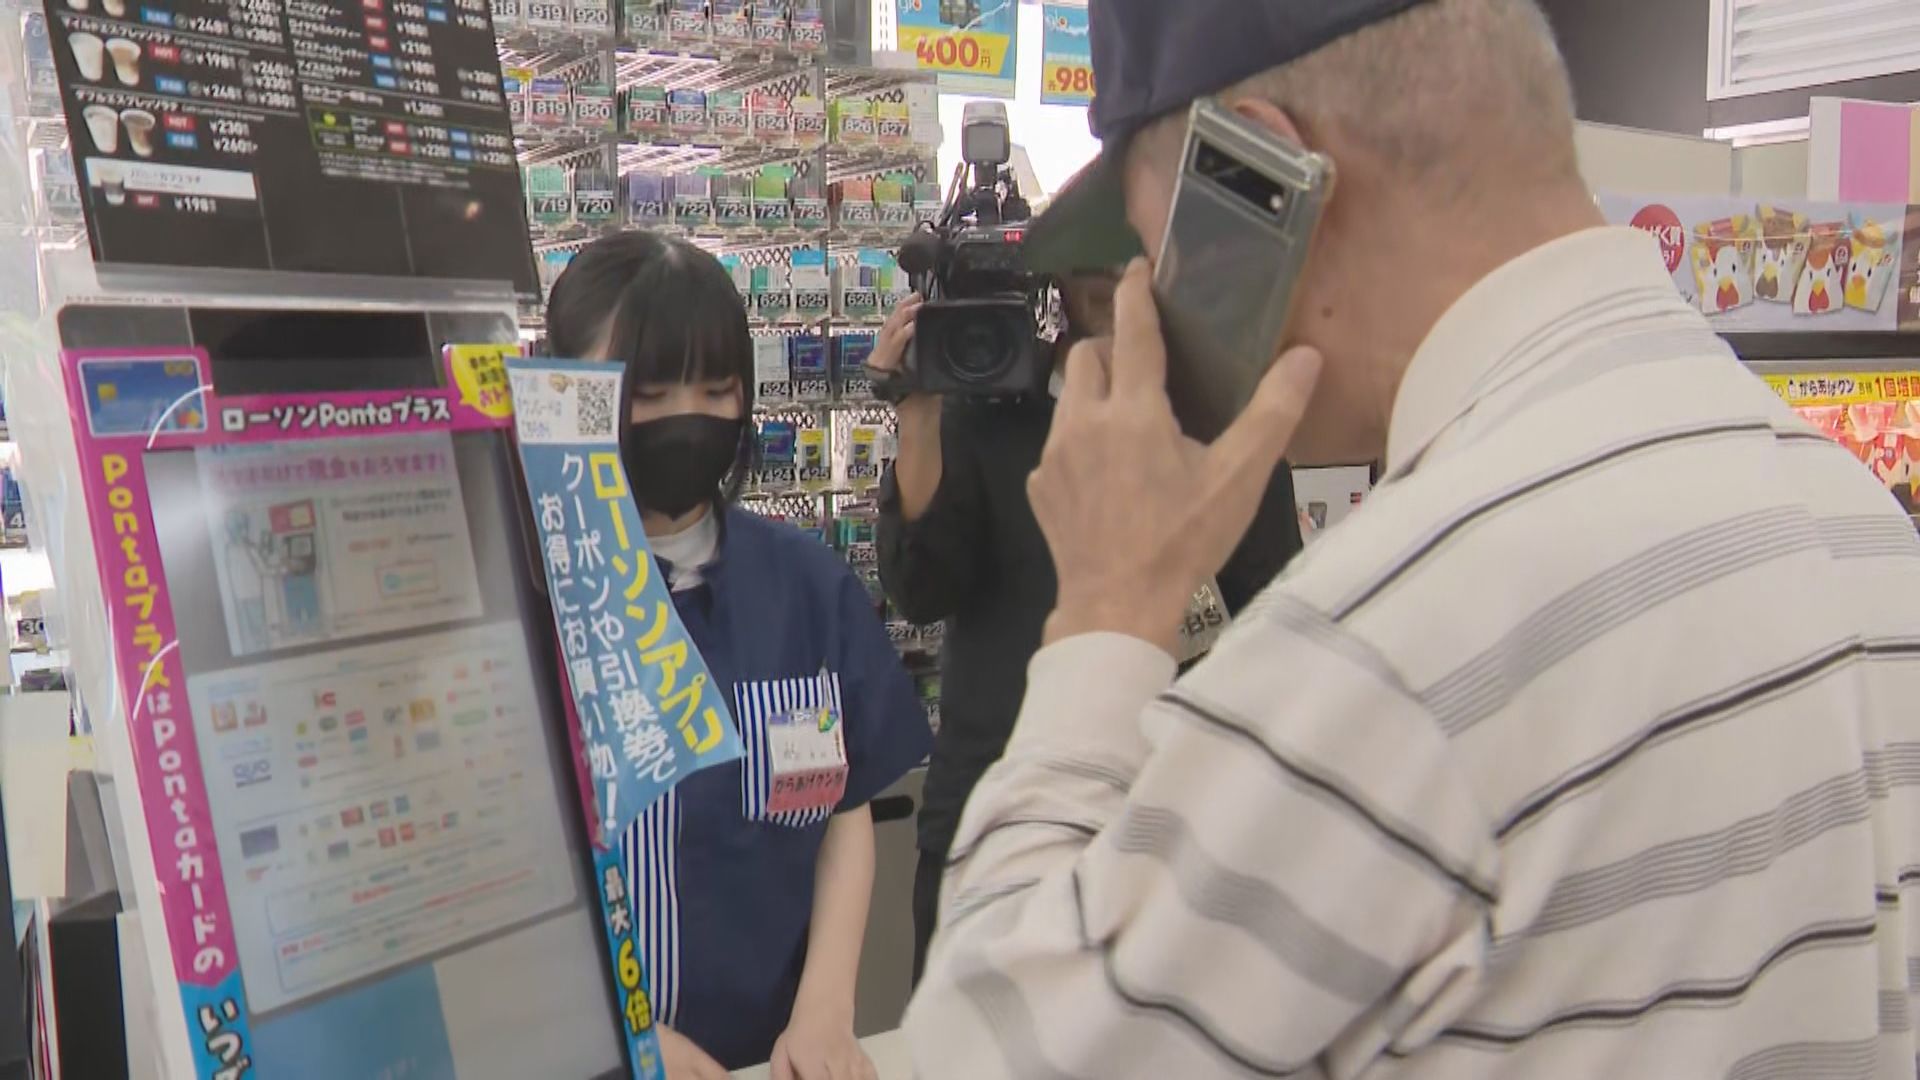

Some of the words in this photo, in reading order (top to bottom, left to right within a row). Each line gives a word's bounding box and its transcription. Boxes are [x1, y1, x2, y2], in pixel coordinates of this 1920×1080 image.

[532, 4, 562, 20] 919
[577, 8, 607, 24] 920
[633, 13, 660, 30] 921
[755, 26, 783, 42] 924
[794, 26, 822, 44] 925
[916, 35, 979, 68] 400
[536, 99, 566, 115] 819
[580, 103, 609, 119] 820
[635, 105, 662, 121] 821
[676, 108, 703, 125] 822
[718, 111, 746, 127] 823
[757, 116, 786, 131] 824
[797, 118, 824, 132] 825
[880, 121, 905, 136] 827
[539, 199, 567, 213] 719
[582, 199, 612, 214] 720
[637, 203, 663, 218] 721
[680, 202, 708, 218] 722
[719, 202, 748, 218] 723
[756, 207, 784, 220] 724
[799, 207, 824, 221] 725
[847, 208, 872, 221] 726
[881, 209, 907, 222] 727
[761, 294, 788, 307] 624
[799, 294, 826, 307] 625
[848, 294, 873, 307] 626
[800, 380, 827, 395] 525
[222, 397, 451, 434] ローソンPontaプラス
[588, 452, 724, 756] ローソンアプリ
[562, 452, 678, 784] クーポンや引換券で
[101, 454, 224, 975] PontaプラスはPontaカードの
